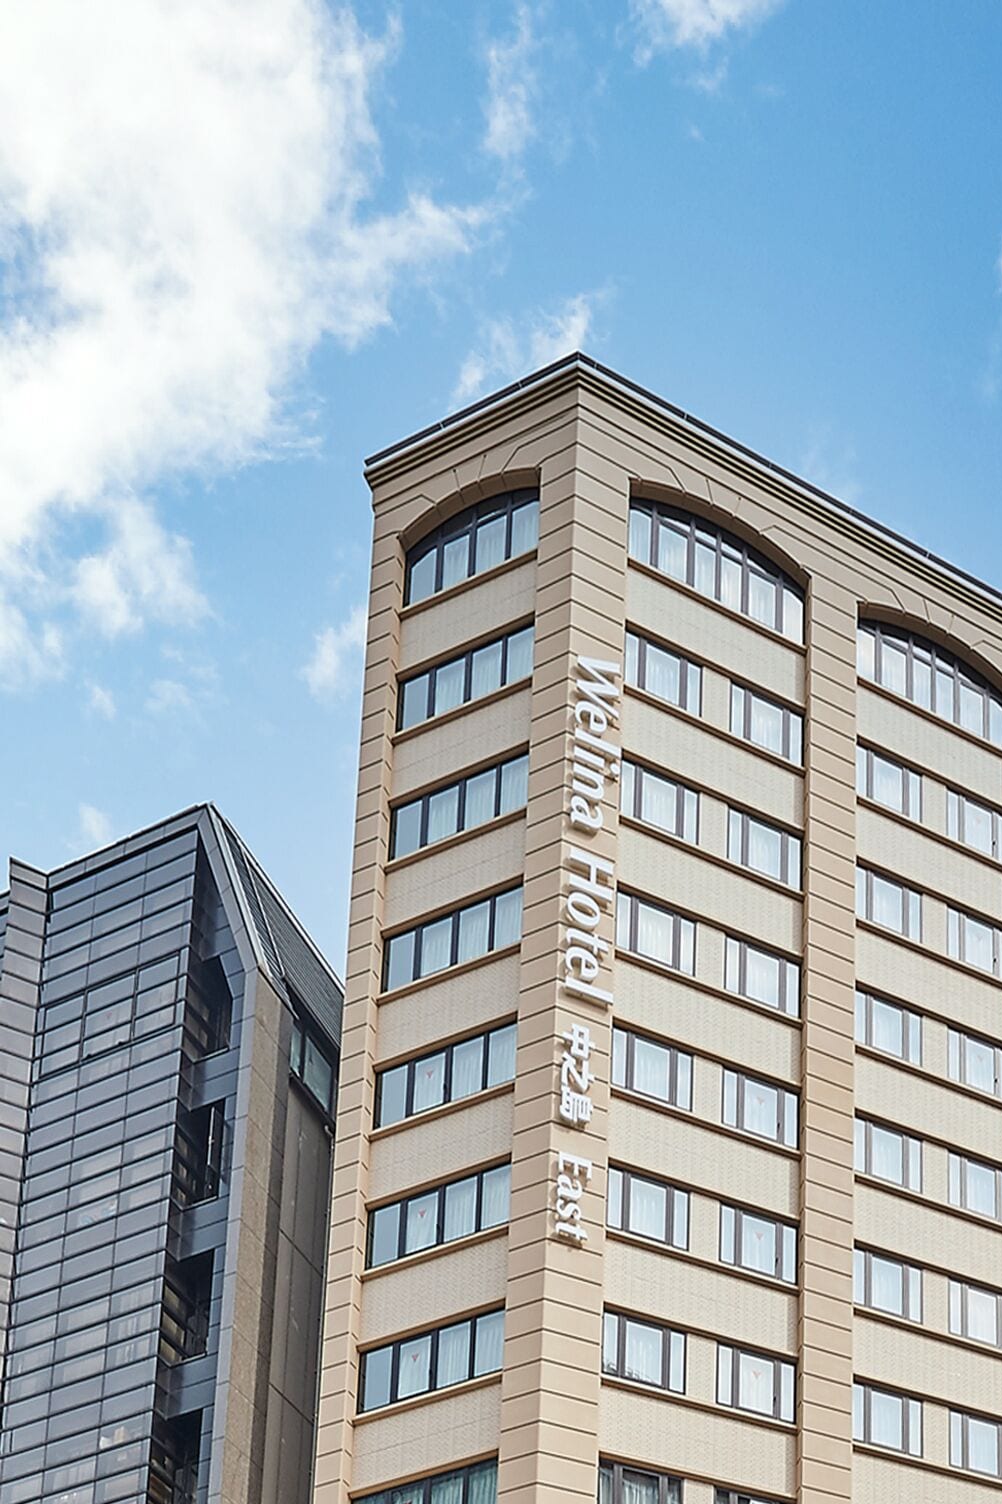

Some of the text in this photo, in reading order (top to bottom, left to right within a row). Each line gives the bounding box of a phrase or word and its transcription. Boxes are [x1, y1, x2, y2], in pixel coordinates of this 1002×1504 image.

[556, 655, 622, 1240] Welina Hotel 中之島 East
